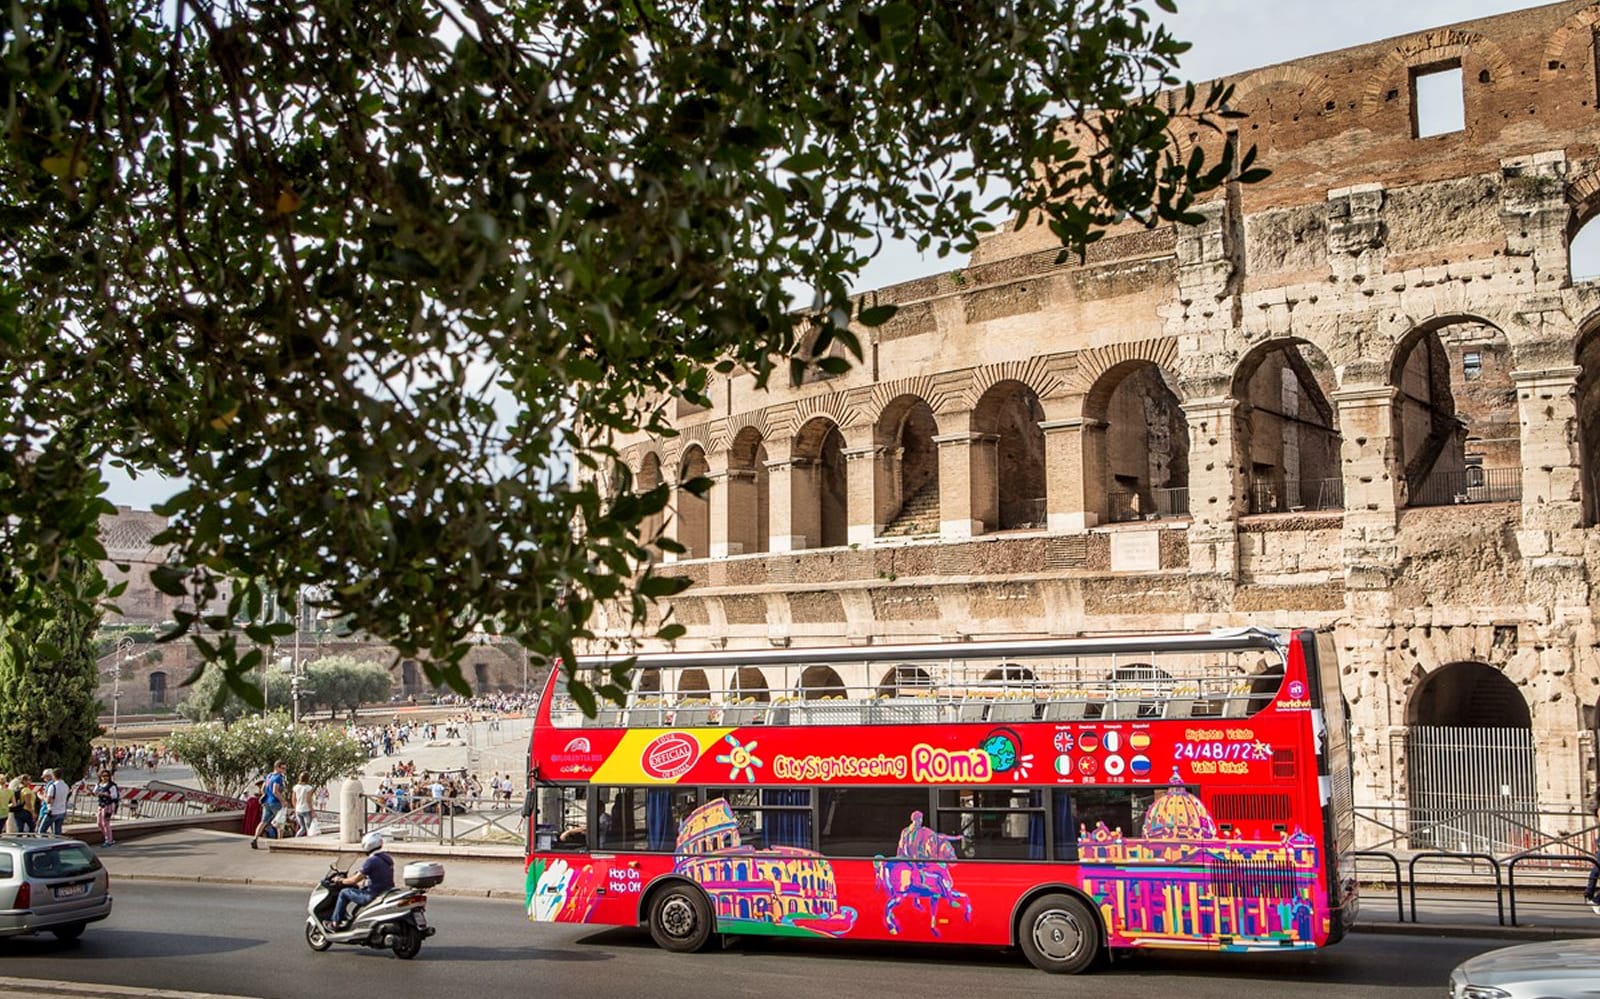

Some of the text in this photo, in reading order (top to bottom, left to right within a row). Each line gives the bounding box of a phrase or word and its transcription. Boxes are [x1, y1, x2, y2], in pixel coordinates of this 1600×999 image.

[650, 744, 690, 767] OFFICIAL
[1174, 742, 1251, 760] 24/48/72
[773, 743, 992, 782] CitySightseeing Roma
[609, 868, 640, 880] Hop On
[610, 881, 642, 893] Hop Off
